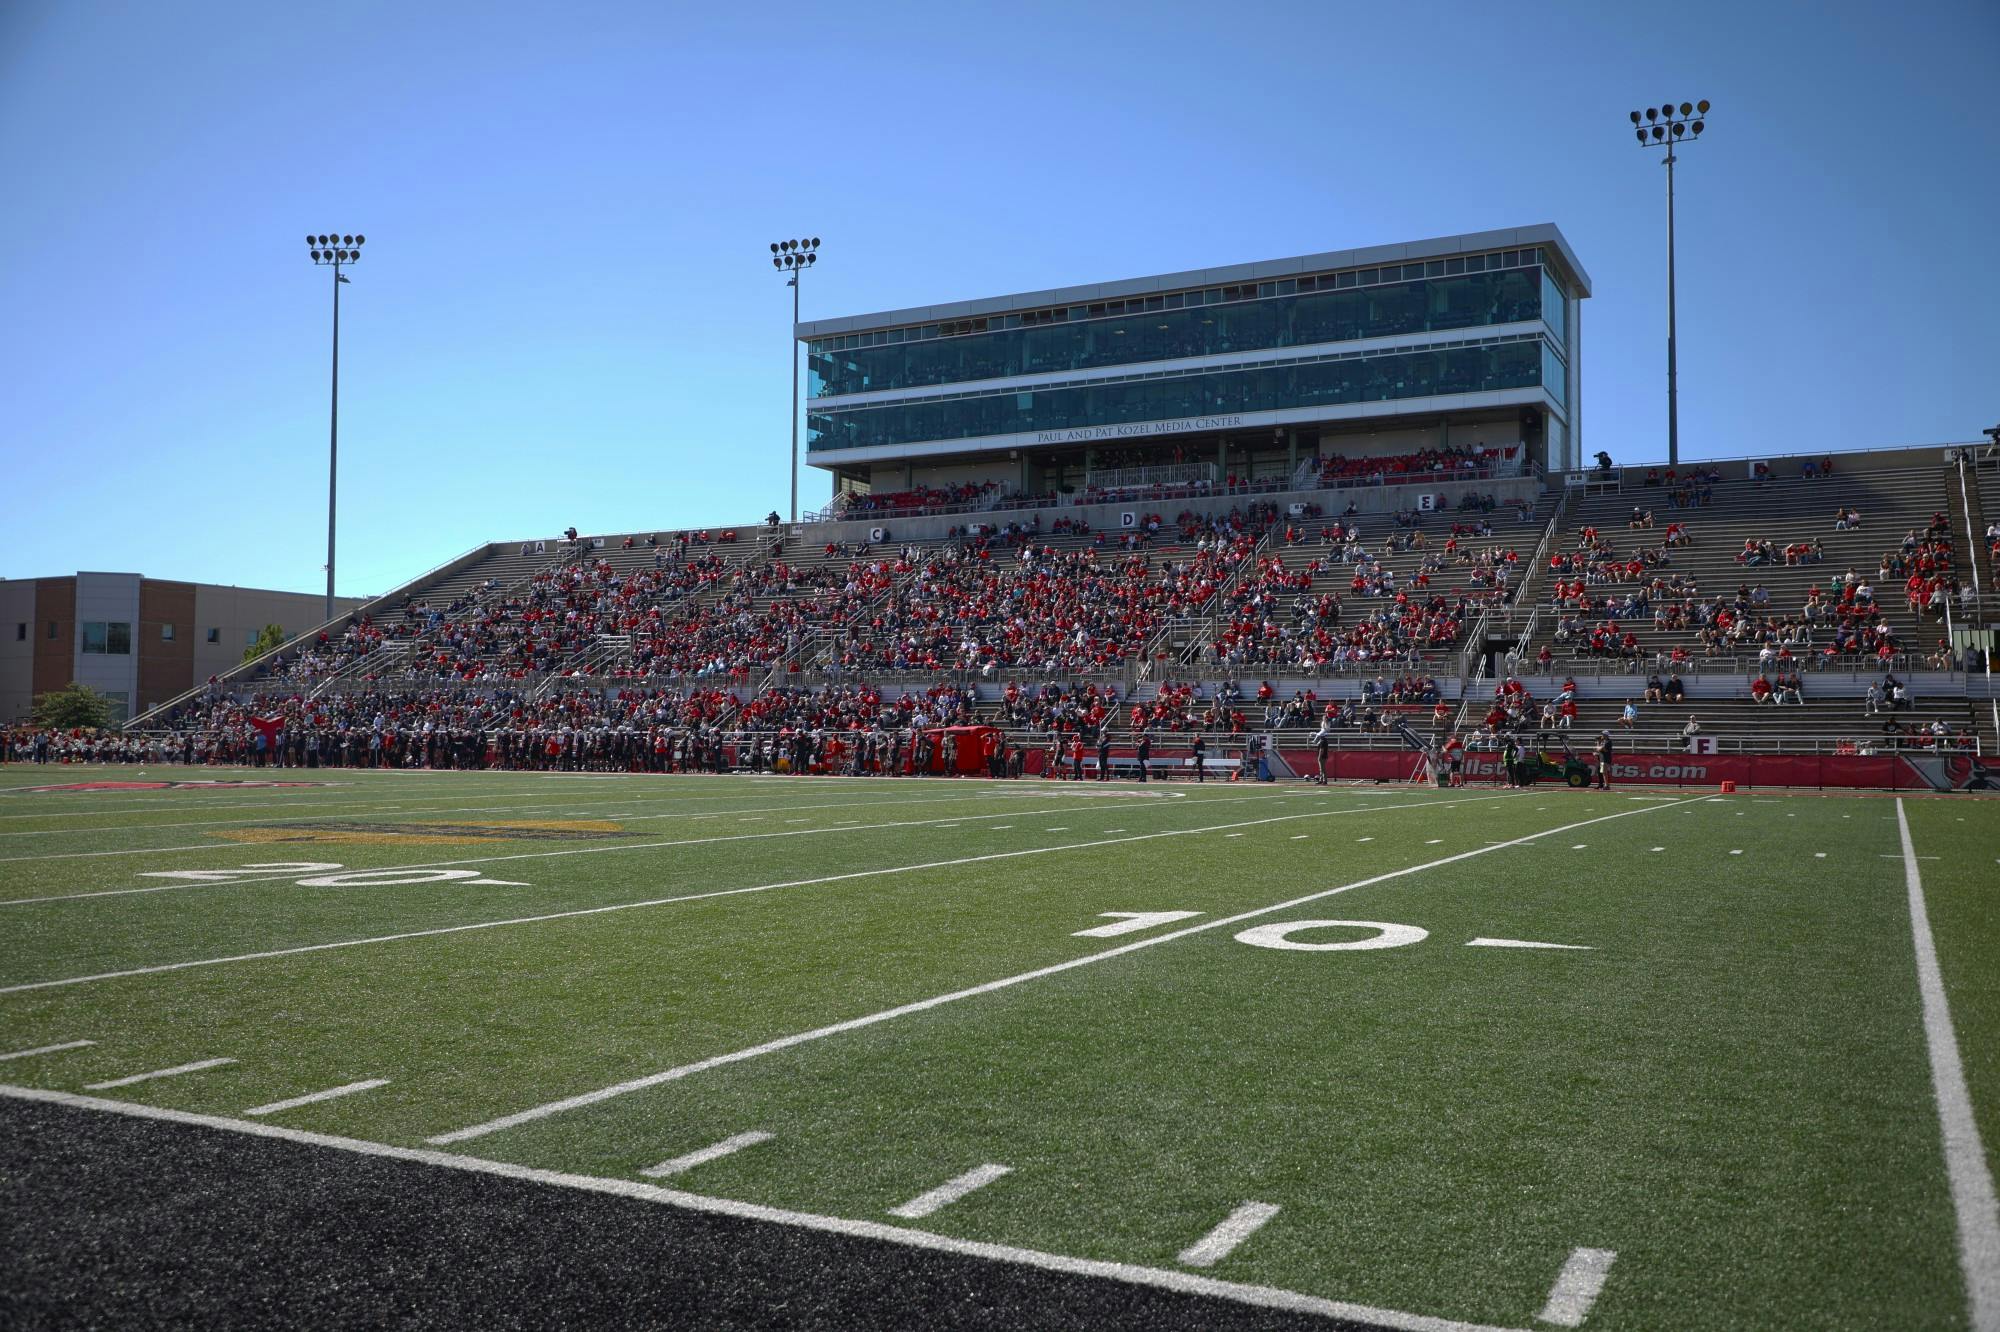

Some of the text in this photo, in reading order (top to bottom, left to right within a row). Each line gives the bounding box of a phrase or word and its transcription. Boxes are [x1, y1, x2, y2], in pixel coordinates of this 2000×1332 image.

[1038, 416, 1241, 443] PAUL AND PAT KOZEL MEDIA CENTER
[1421, 496, 1431, 509] E
[1123, 513, 1134, 526] D
[872, 528, 881, 540] C
[536, 542, 545, 553] A
[1697, 738, 1711, 754] F
[1070, 910, 1429, 951] 10
